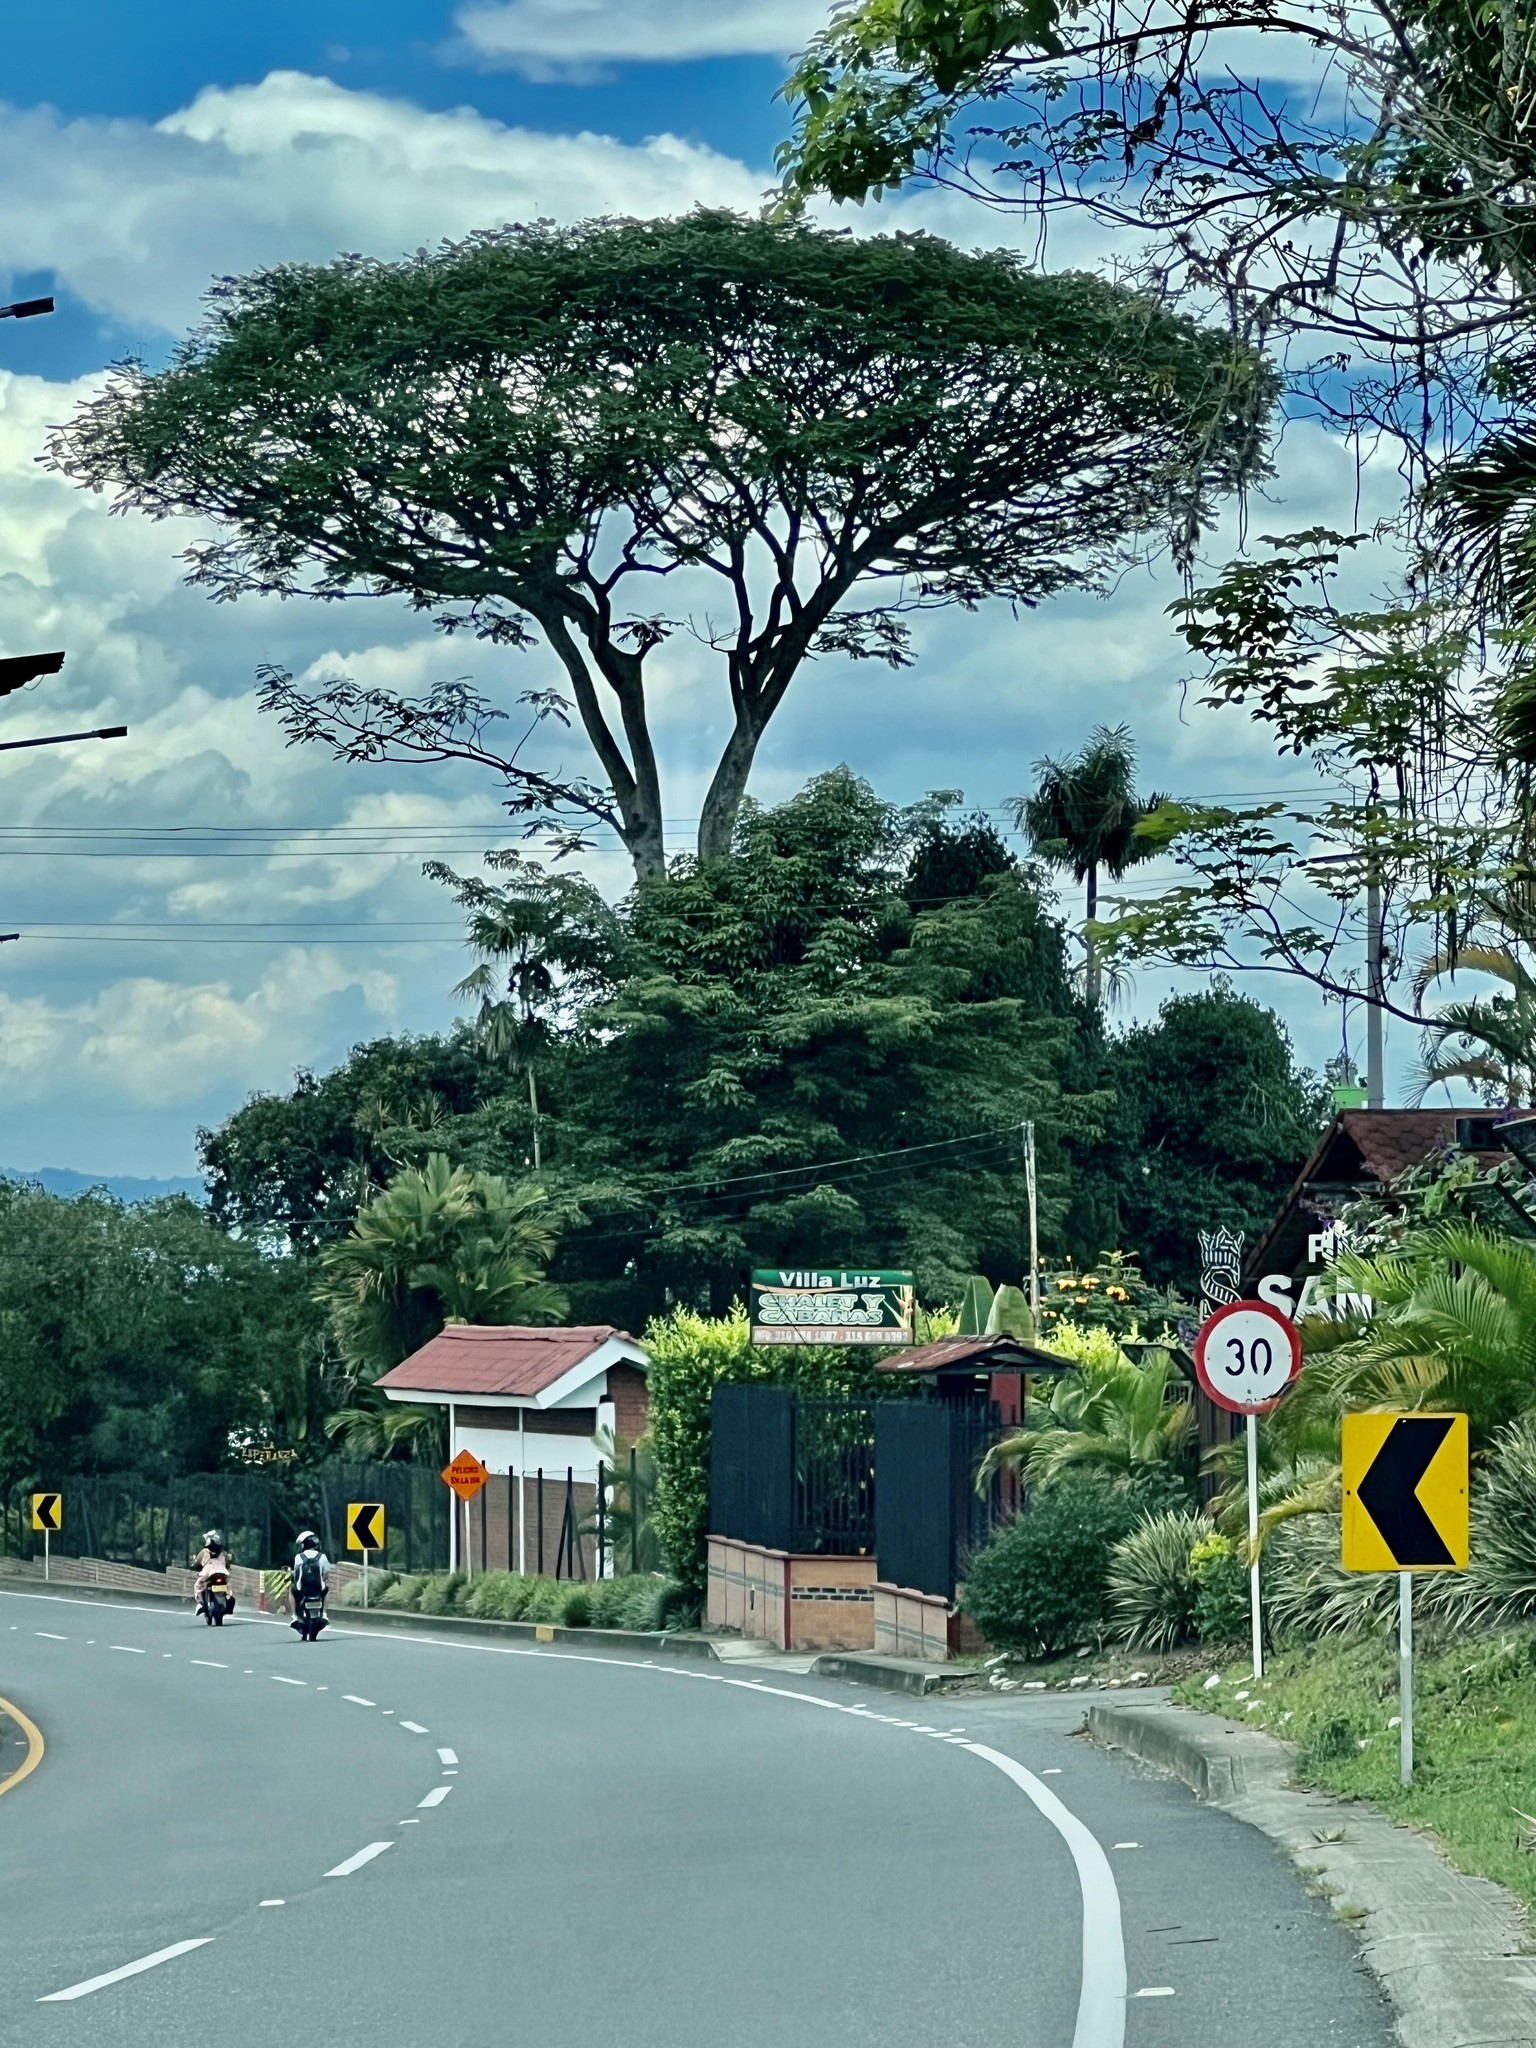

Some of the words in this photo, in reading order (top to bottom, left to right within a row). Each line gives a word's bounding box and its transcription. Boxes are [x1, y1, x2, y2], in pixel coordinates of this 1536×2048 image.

[779, 1272, 833, 1288] Villa
[840, 1272, 881, 1288] Luz
[759, 1294, 859, 1310] CHALET
[861, 1294, 886, 1311] Y
[1225, 1338, 1273, 1376] 30
